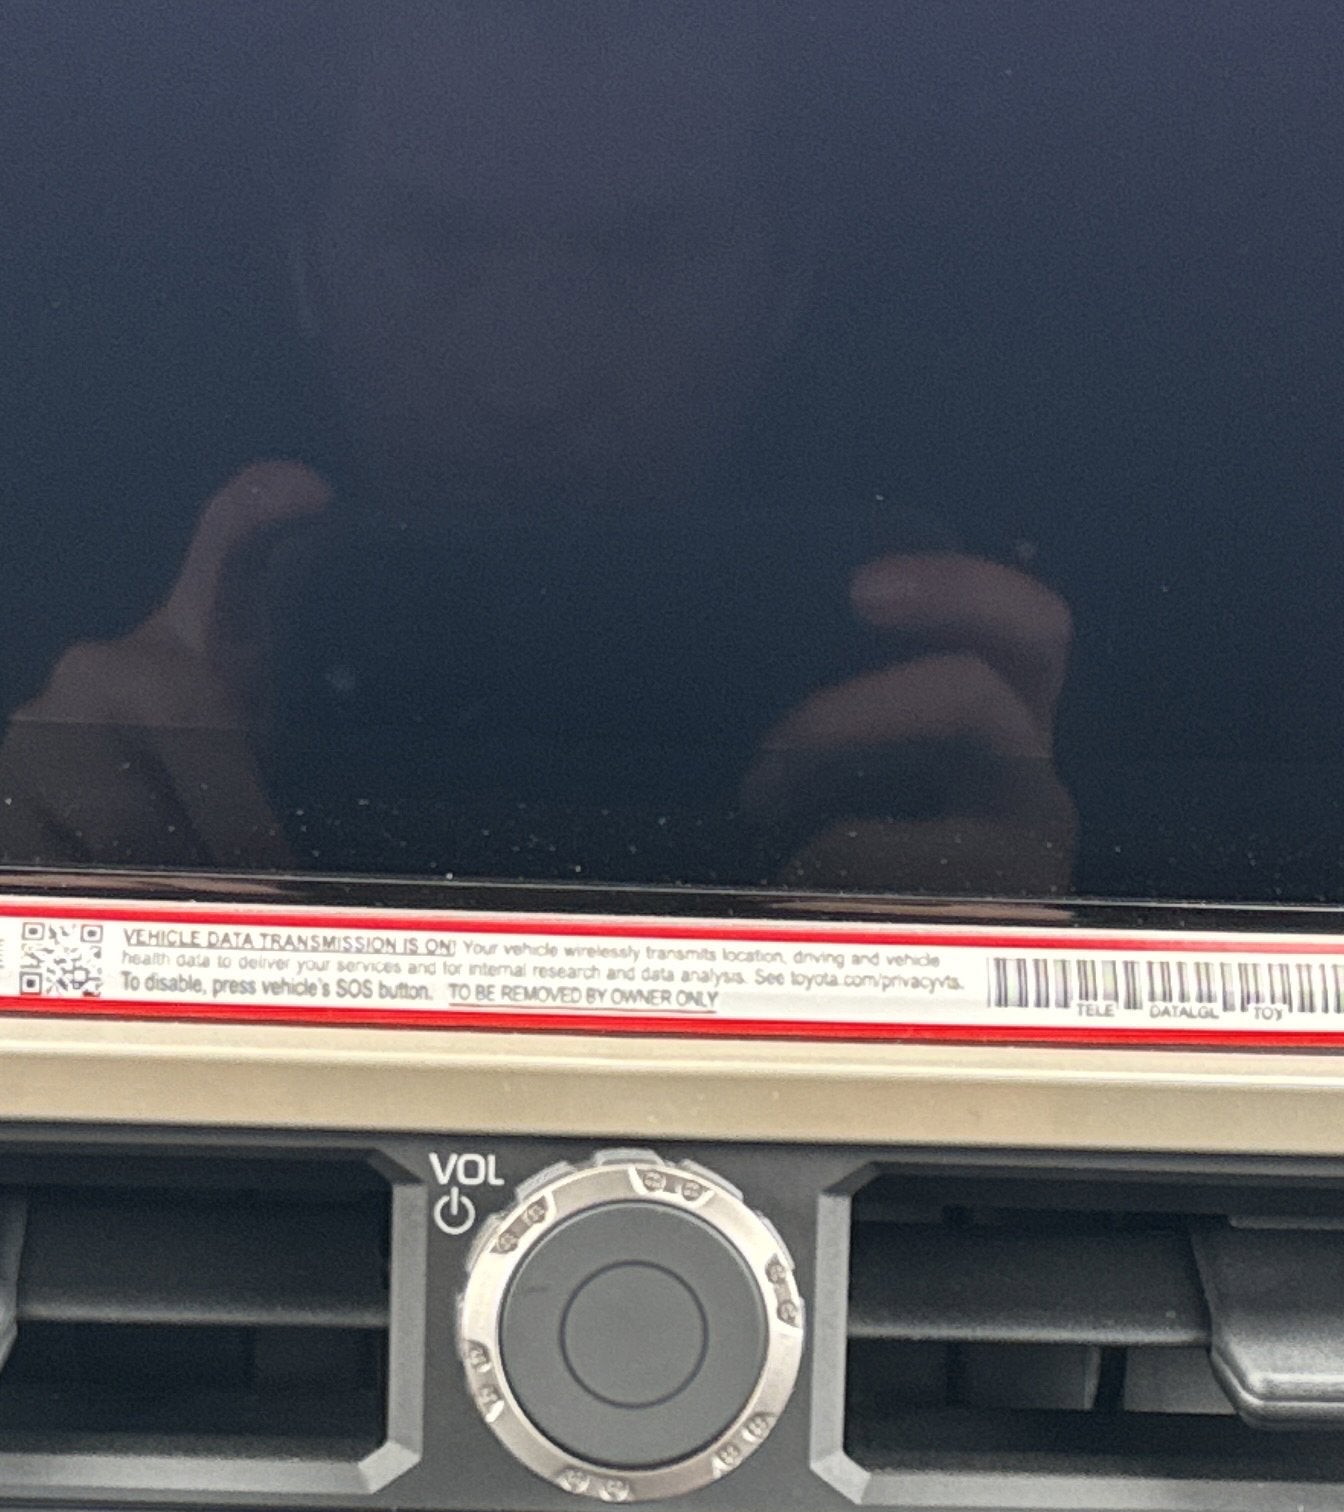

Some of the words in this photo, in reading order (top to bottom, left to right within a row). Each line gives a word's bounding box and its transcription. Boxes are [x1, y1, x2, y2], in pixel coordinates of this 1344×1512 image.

[123, 928, 201, 947] VEHICLE
[207, 931, 254, 949] DATA
[259, 932, 396, 954] TRANSMISSION
[403, 937, 419, 955] IS
[463, 939, 499, 956] Your
[504, 942, 558, 957] vehicle
[564, 944, 640, 963] wirelessly
[646, 945, 717, 962] transmits
[793, 949, 845, 969] driving
[851, 951, 879, 966] and
[886, 953, 940, 967] vehicle
[121, 949, 170, 965] health
[176, 952, 210, 968] data
[217, 955, 232, 969] to
[239, 954, 291, 970] deliver
[296, 959, 331, 976] your
[336, 959, 401, 974] services
[407, 960, 436, 975] and
[443, 960, 463, 976] for
[469, 962, 527, 977] internal
[533, 964, 601, 980] research
[606, 966, 636, 981] and
[641, 967, 675, 982] data
[681, 968, 747, 987] analysis.
[755, 968, 785, 986] See
[120, 970, 140, 991] To
[144, 972, 207, 995] disable,
[212, 977, 257, 998] press
[262, 977, 331, 998] vehicle's
[335, 978, 373, 999] SOS
[378, 980, 433, 1000] button.
[448, 982, 471, 1001] TO
[475, 984, 496, 1001] BE
[501, 985, 582, 1004] REMOVED
[586, 987, 607, 1005] BY
[610, 987, 672, 1006] OWNER
[676, 989, 719, 1008] ONLY
[1077, 1003, 1115, 1018] TELE
[1253, 1006, 1283, 1021] TOY
[428, 1152, 505, 1186] VOL
